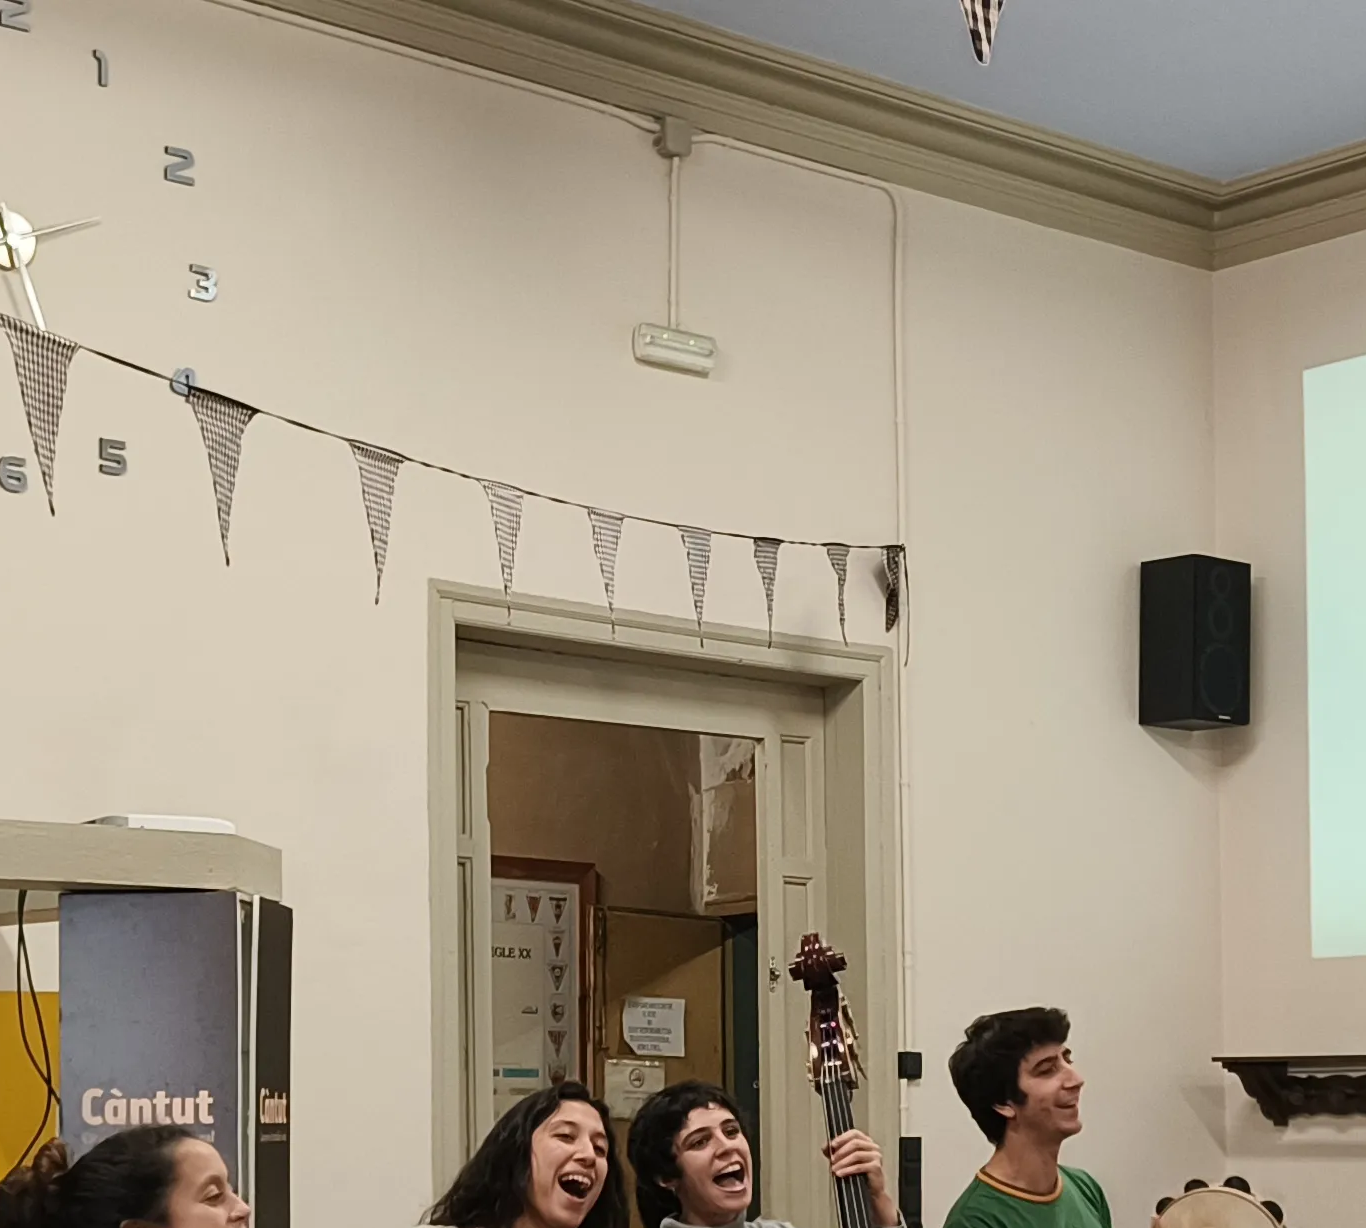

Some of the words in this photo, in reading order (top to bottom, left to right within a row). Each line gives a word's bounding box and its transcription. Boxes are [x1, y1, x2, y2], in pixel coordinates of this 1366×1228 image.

[92, 49, 108, 87] 1
[164, 146, 195, 187] 2
[188, 264, 217, 302] 3
[98, 437, 127, 476] 5
[82, 1088, 214, 1125] Càntut
